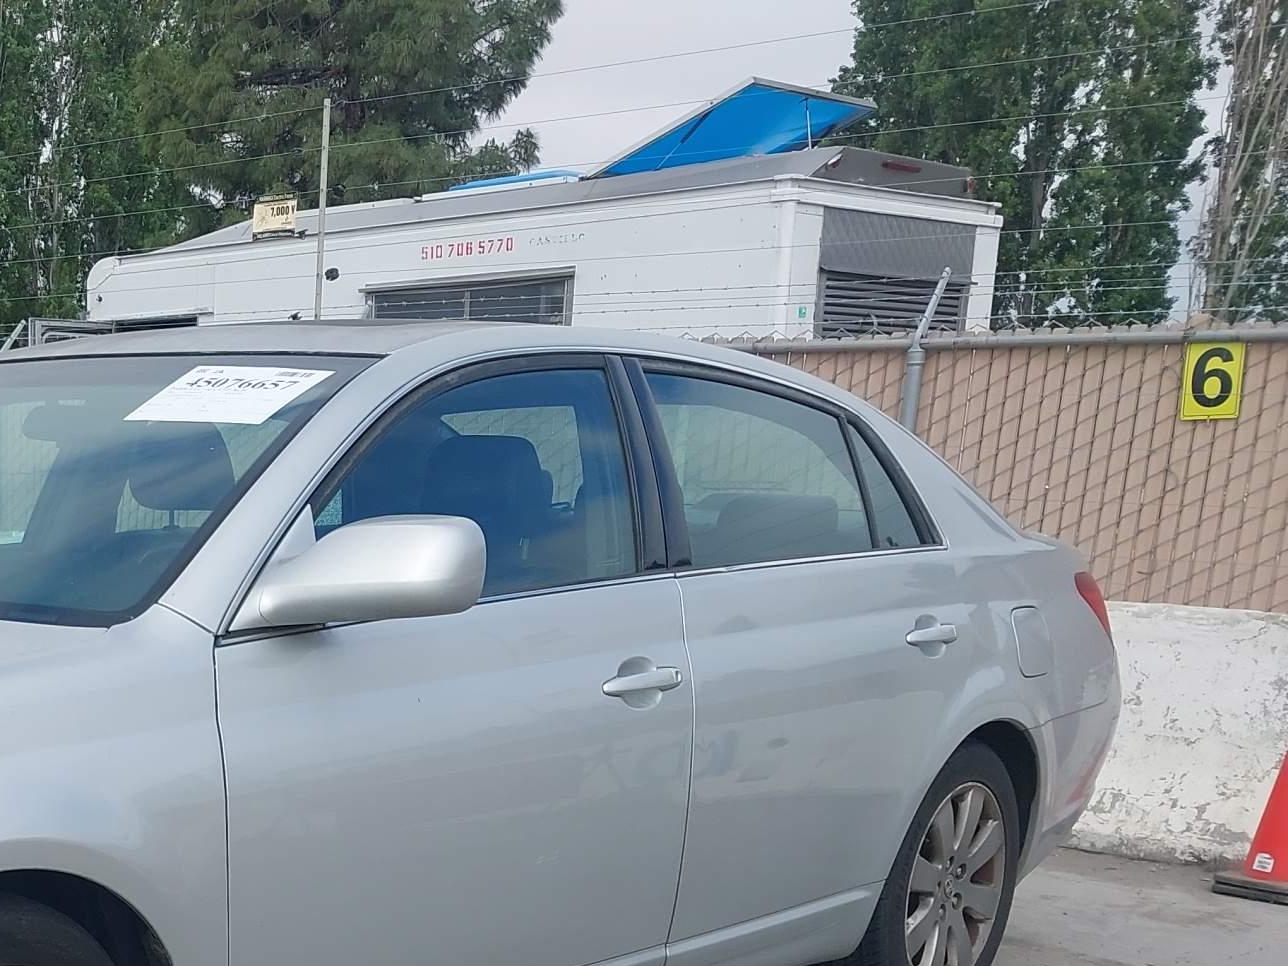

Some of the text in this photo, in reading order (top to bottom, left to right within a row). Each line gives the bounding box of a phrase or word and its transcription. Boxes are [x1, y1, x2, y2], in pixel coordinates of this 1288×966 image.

[270, 205, 290, 219] 7,000
[421, 245, 443, 260] 510
[448, 241, 473, 258] 706
[478, 237, 513, 255] 5770
[1191, 346, 1235, 408] 6
